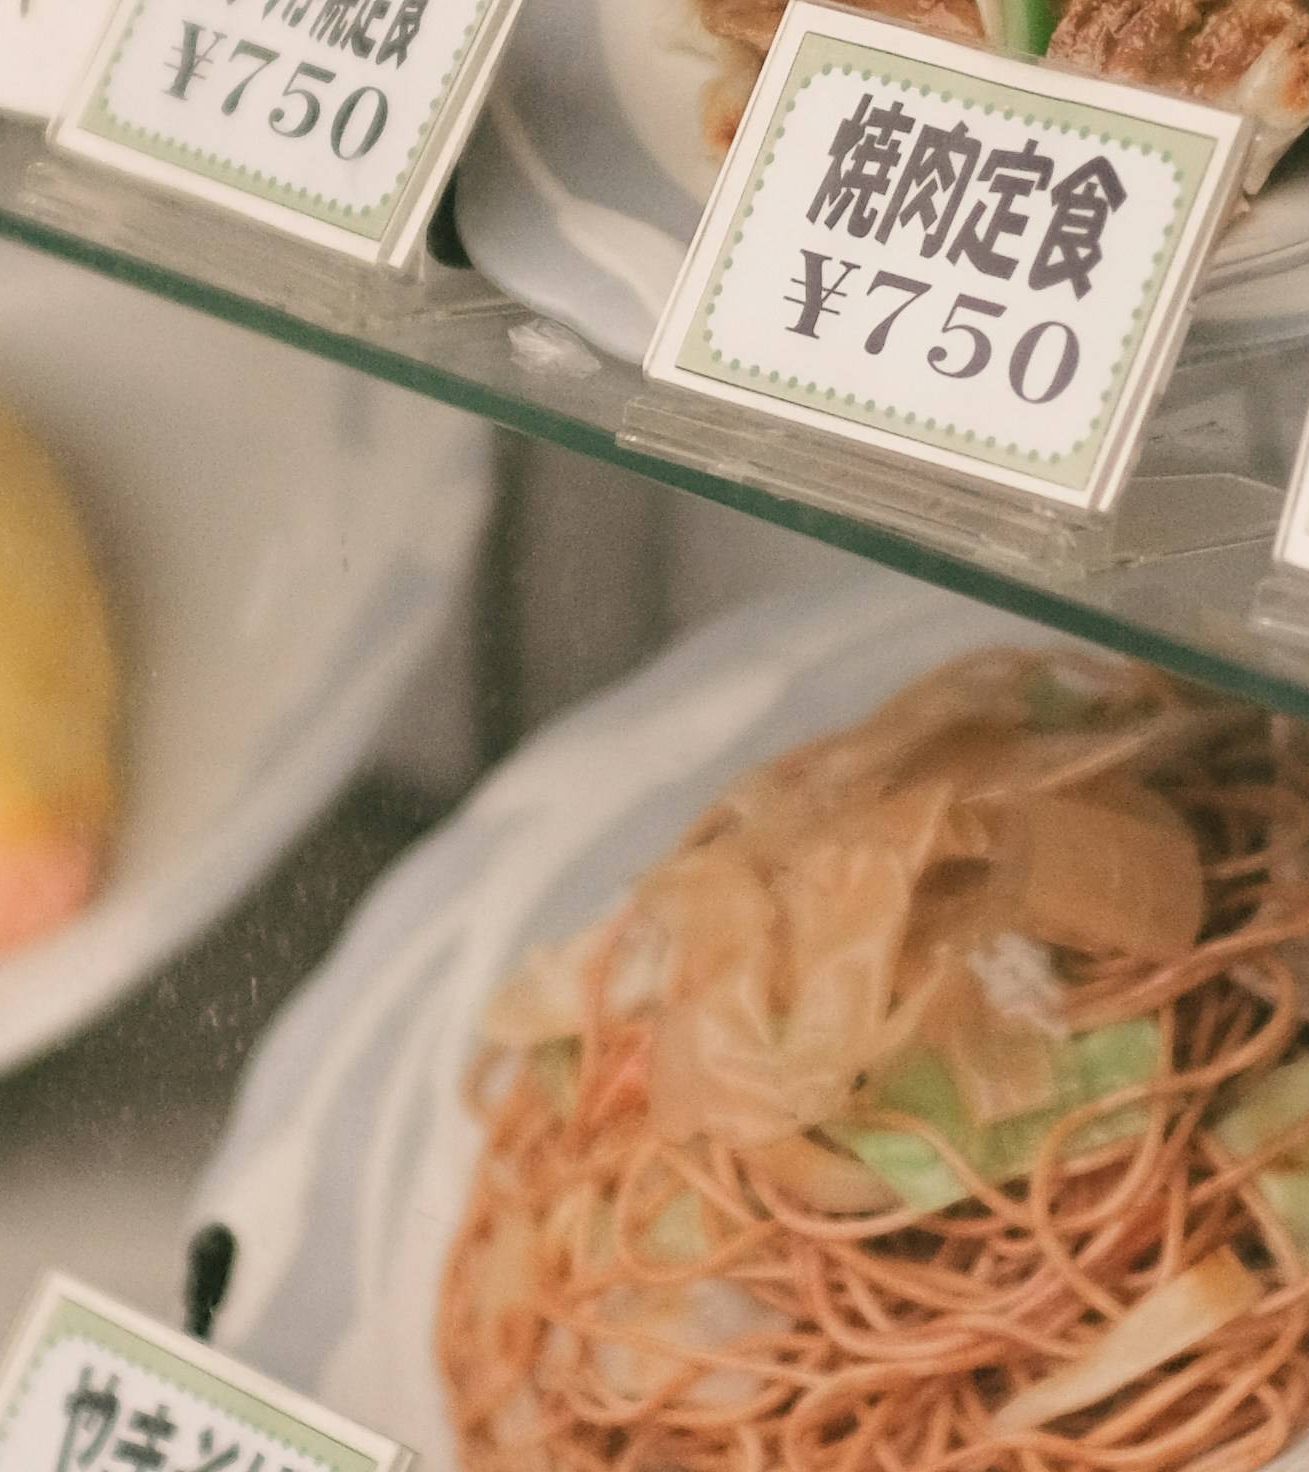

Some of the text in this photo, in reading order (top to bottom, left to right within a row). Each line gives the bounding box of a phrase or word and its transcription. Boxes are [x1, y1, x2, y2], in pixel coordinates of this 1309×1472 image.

[163, 19, 390, 161] ¥750
[805, 93, 1128, 301] 焼肉定食
[783, 248, 1080, 405] ¥750
